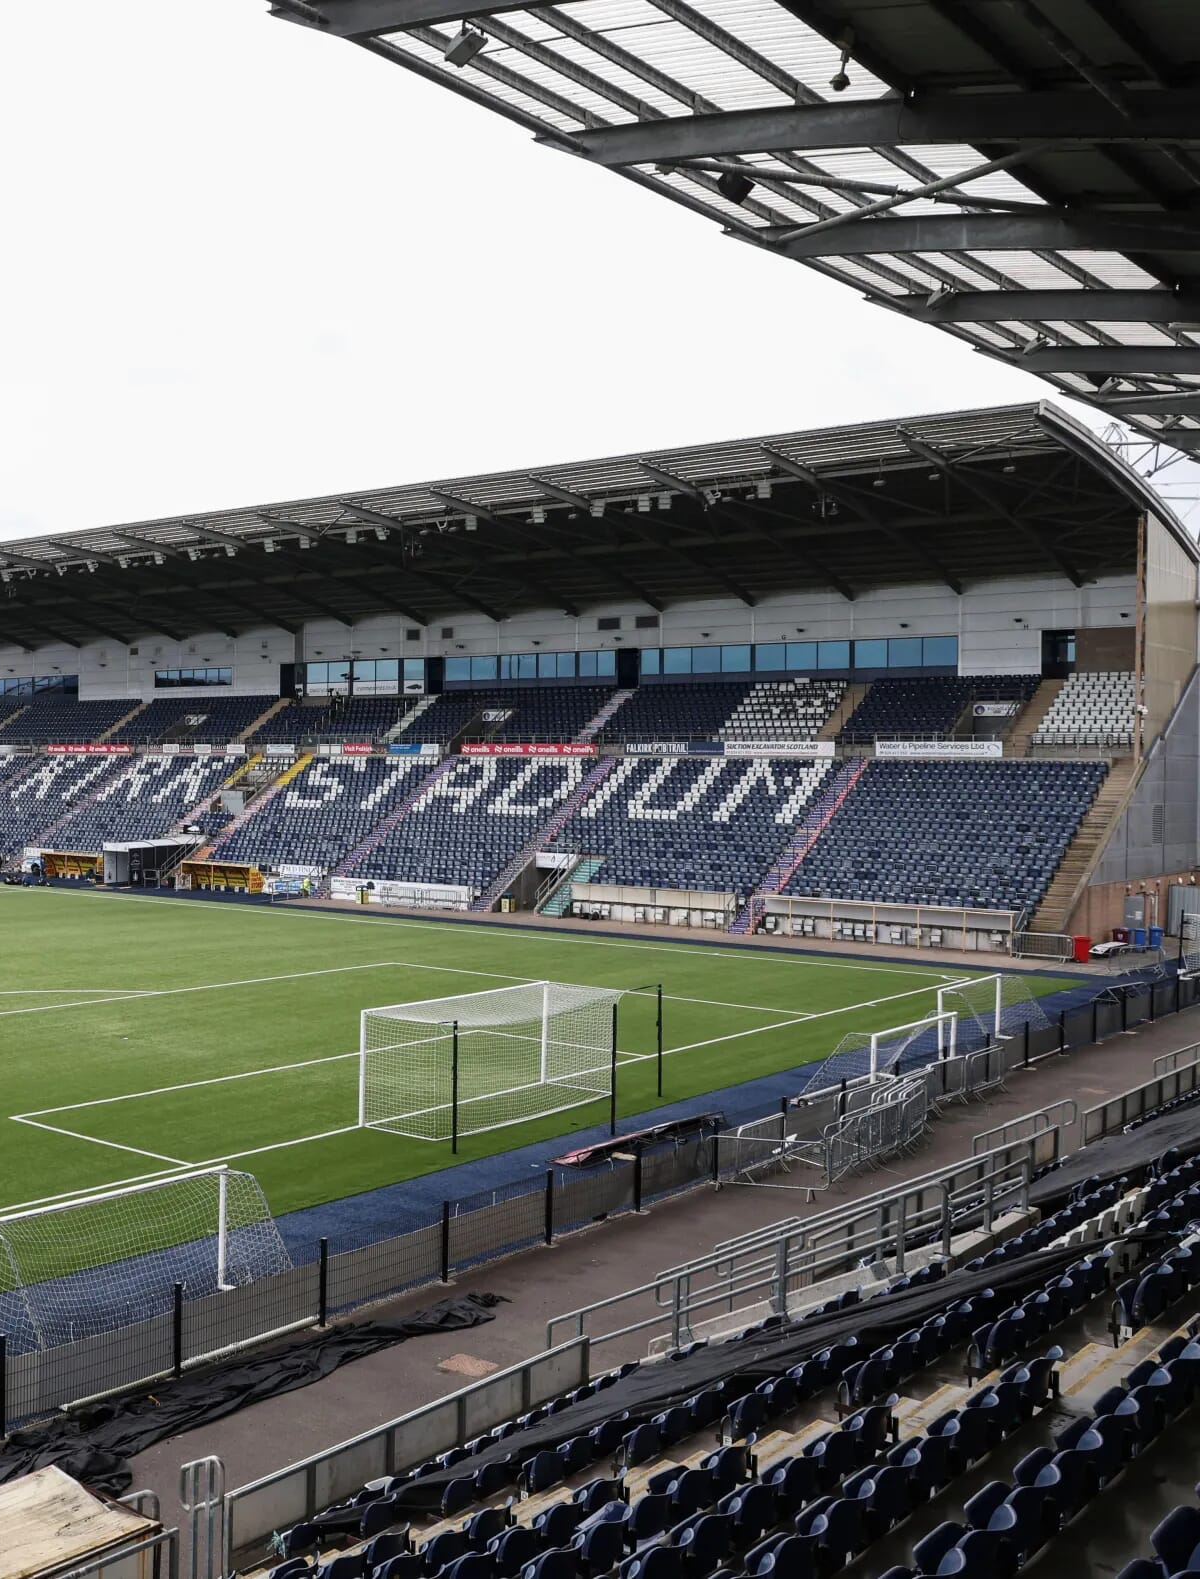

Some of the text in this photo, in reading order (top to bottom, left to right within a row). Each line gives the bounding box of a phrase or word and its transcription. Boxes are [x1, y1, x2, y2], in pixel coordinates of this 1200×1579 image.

[626, 743, 653, 753] FALKIRK
[668, 743, 687, 753] TRAIL
[908, 742, 936, 751] Pipeline
[284, 755, 833, 824] STADIUM
